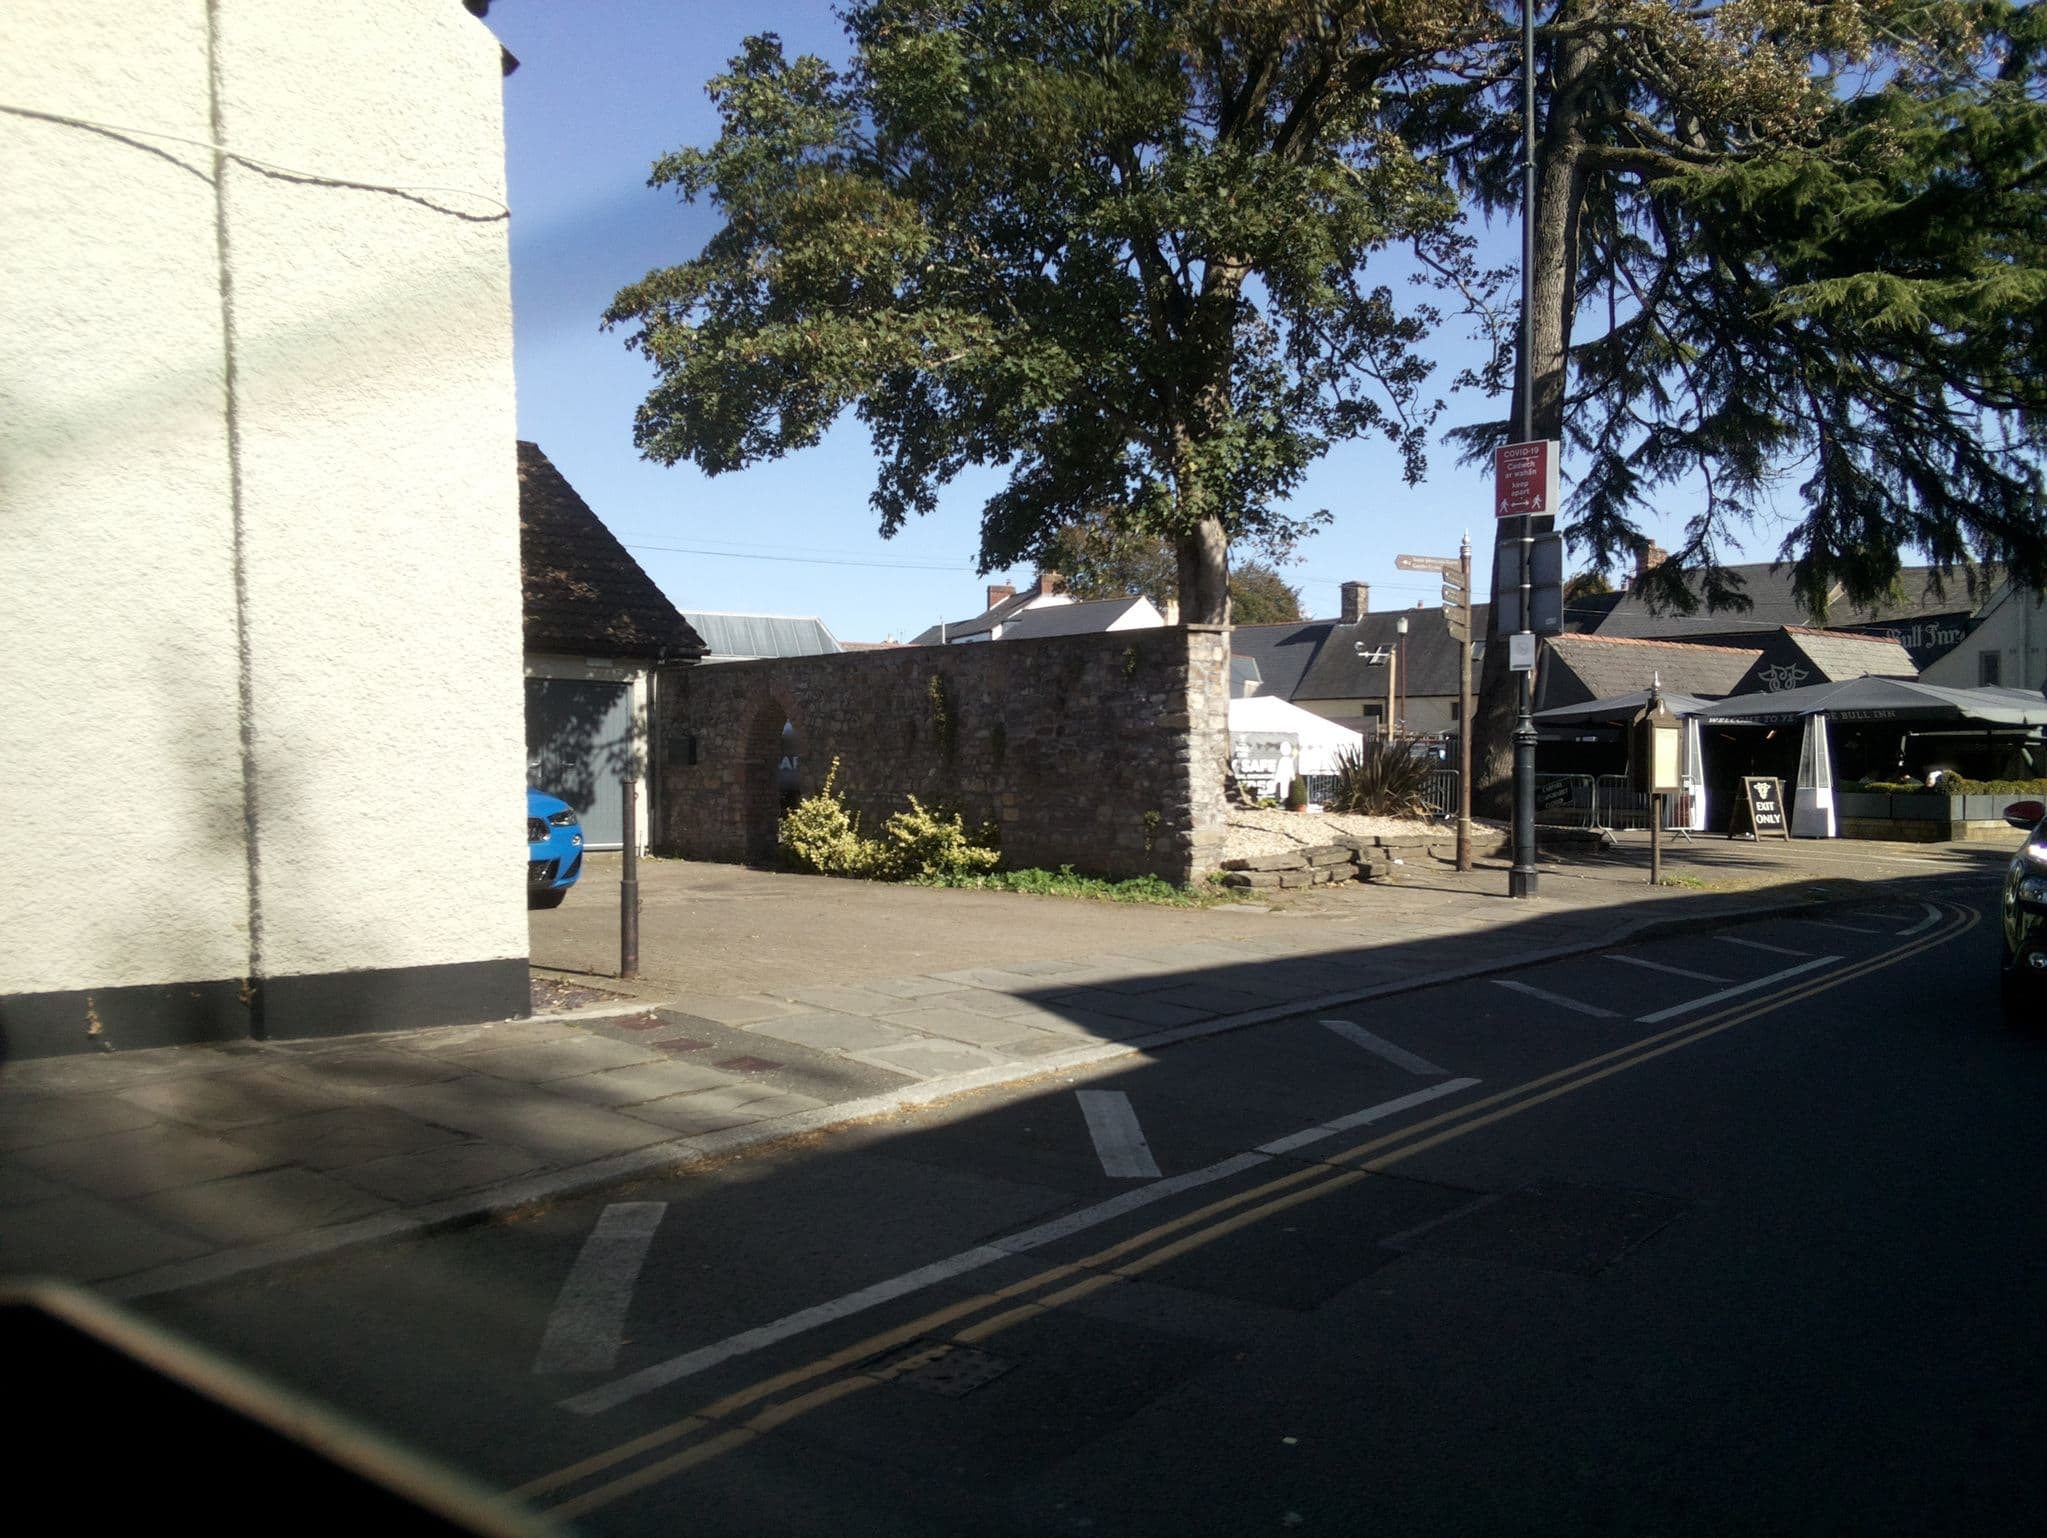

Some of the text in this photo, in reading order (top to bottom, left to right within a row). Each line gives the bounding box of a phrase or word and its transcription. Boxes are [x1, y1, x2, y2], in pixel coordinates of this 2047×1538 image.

[1503, 447, 1539, 458] COVID-19
[1241, 758, 1277, 773] SAFE
[1755, 801, 1775, 811] EXIT
[1755, 813, 1781, 824] ONLY
